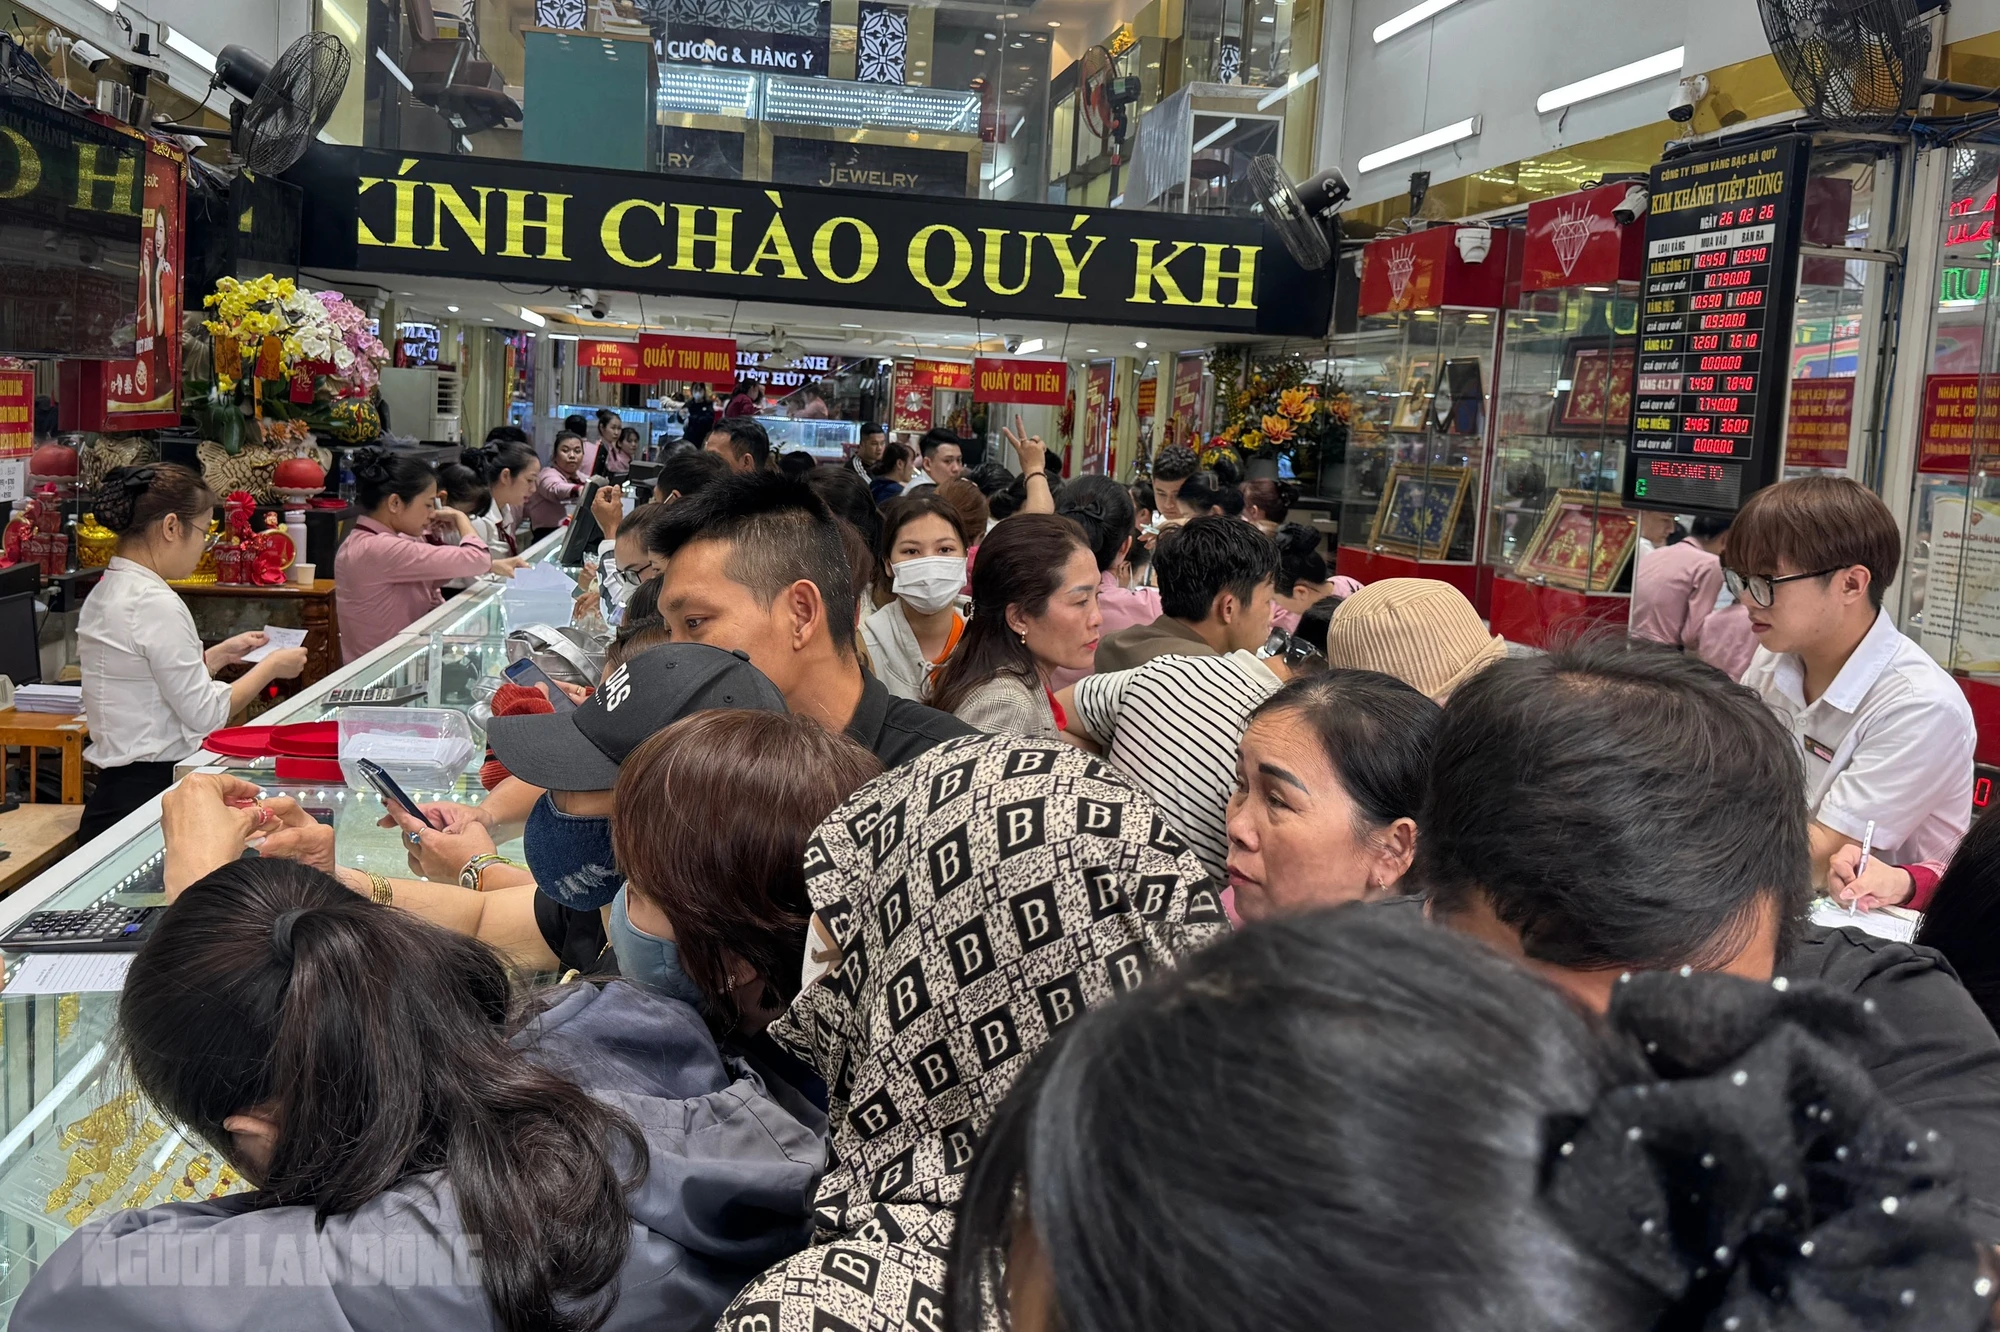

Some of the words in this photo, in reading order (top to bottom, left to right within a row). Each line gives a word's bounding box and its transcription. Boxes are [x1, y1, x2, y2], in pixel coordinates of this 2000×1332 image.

[731, 47, 747, 63] &
[750, 45, 797, 69] HÀNG
[801, 50, 814, 69] Ý
[1661, 168, 1679, 182] CÔNG
[1680, 167, 1689, 178] TY
[1691, 164, 1709, 175] TNHH
[1710, 157, 1729, 171] VÀNG
[1731, 155, 1747, 169] BẠC
[1748, 151, 1759, 163] ĐÁ
[1761, 146, 1777, 161] QUÝ
[1650, 193, 1672, 215] KIM
[1673, 181, 1715, 212] KHÁNH
[1717, 173, 1746, 205] VIỆT
[1745, 169, 1783, 197] HÙNG
[1739, 208, 1754, 223] 02
[600, 189, 880, 284] CHÀO
[906, 214, 1107, 308] QUÝ
[1125, 238, 1264, 309] KH
[1701, 236, 1714, 249] MUA
[1715, 234, 1727, 247] VÀO
[1742, 232, 1755, 243] BÁN
[1756, 230, 1764, 241] RA
[1651, 261, 1666, 275] VÀNG
[1667, 259, 1683, 273] CÔNG
[1683, 257, 1691, 270] TY
[1661, 281, 1675, 292] QUY
[1657, 320, 1671, 331] QUY
[736, 351, 759, 366] IM
[1644, 338, 1660, 351] VÀNG
[1660, 338, 1673, 350] 41.7
[677, 350, 700, 370] THU
[703, 351, 730, 372] MUA
[1654, 360, 1667, 371] QUY
[1013, 372, 1032, 392] CHI
[1034, 367, 1060, 393] TIỀN
[1639, 378, 1657, 391] VÀNG
[1657, 379, 1671, 391] 41.7
[1672, 379, 1680, 390] W
[1937, 382, 1960, 399] NHÂN
[1983, 380, 2000, 399] HẢI
[1650, 399, 1664, 410] QUY
[1936, 404, 1949, 417] VUI
[1637, 418, 1650, 431] BẠC
[1647, 438, 1660, 449] QUY
[1011, 751, 1046, 774] B
[936, 768, 964, 805] B
[1973, 777, 1992, 808] 0
[1006, 807, 1033, 848] B
[1084, 802, 1112, 829] B
[878, 814, 898, 859] B
[935, 840, 960, 887] B
[1093, 873, 1119, 911] B
[1143, 883, 1166, 915] B
[883, 892, 902, 937] B
[1019, 898, 1049, 942] B
[955, 931, 983, 976] B
[841, 950, 863, 996] B
[1115, 953, 1143, 990] B
[893, 975, 918, 1021] B
[1045, 986, 1076, 1024] B
[980, 1019, 1010, 1061] B
[920, 1053, 949, 1090] B
[859, 1102, 890, 1134] B
[949, 1131, 974, 1169] B
[877, 1161, 904, 1197] B
[832, 1252, 869, 1286] B
